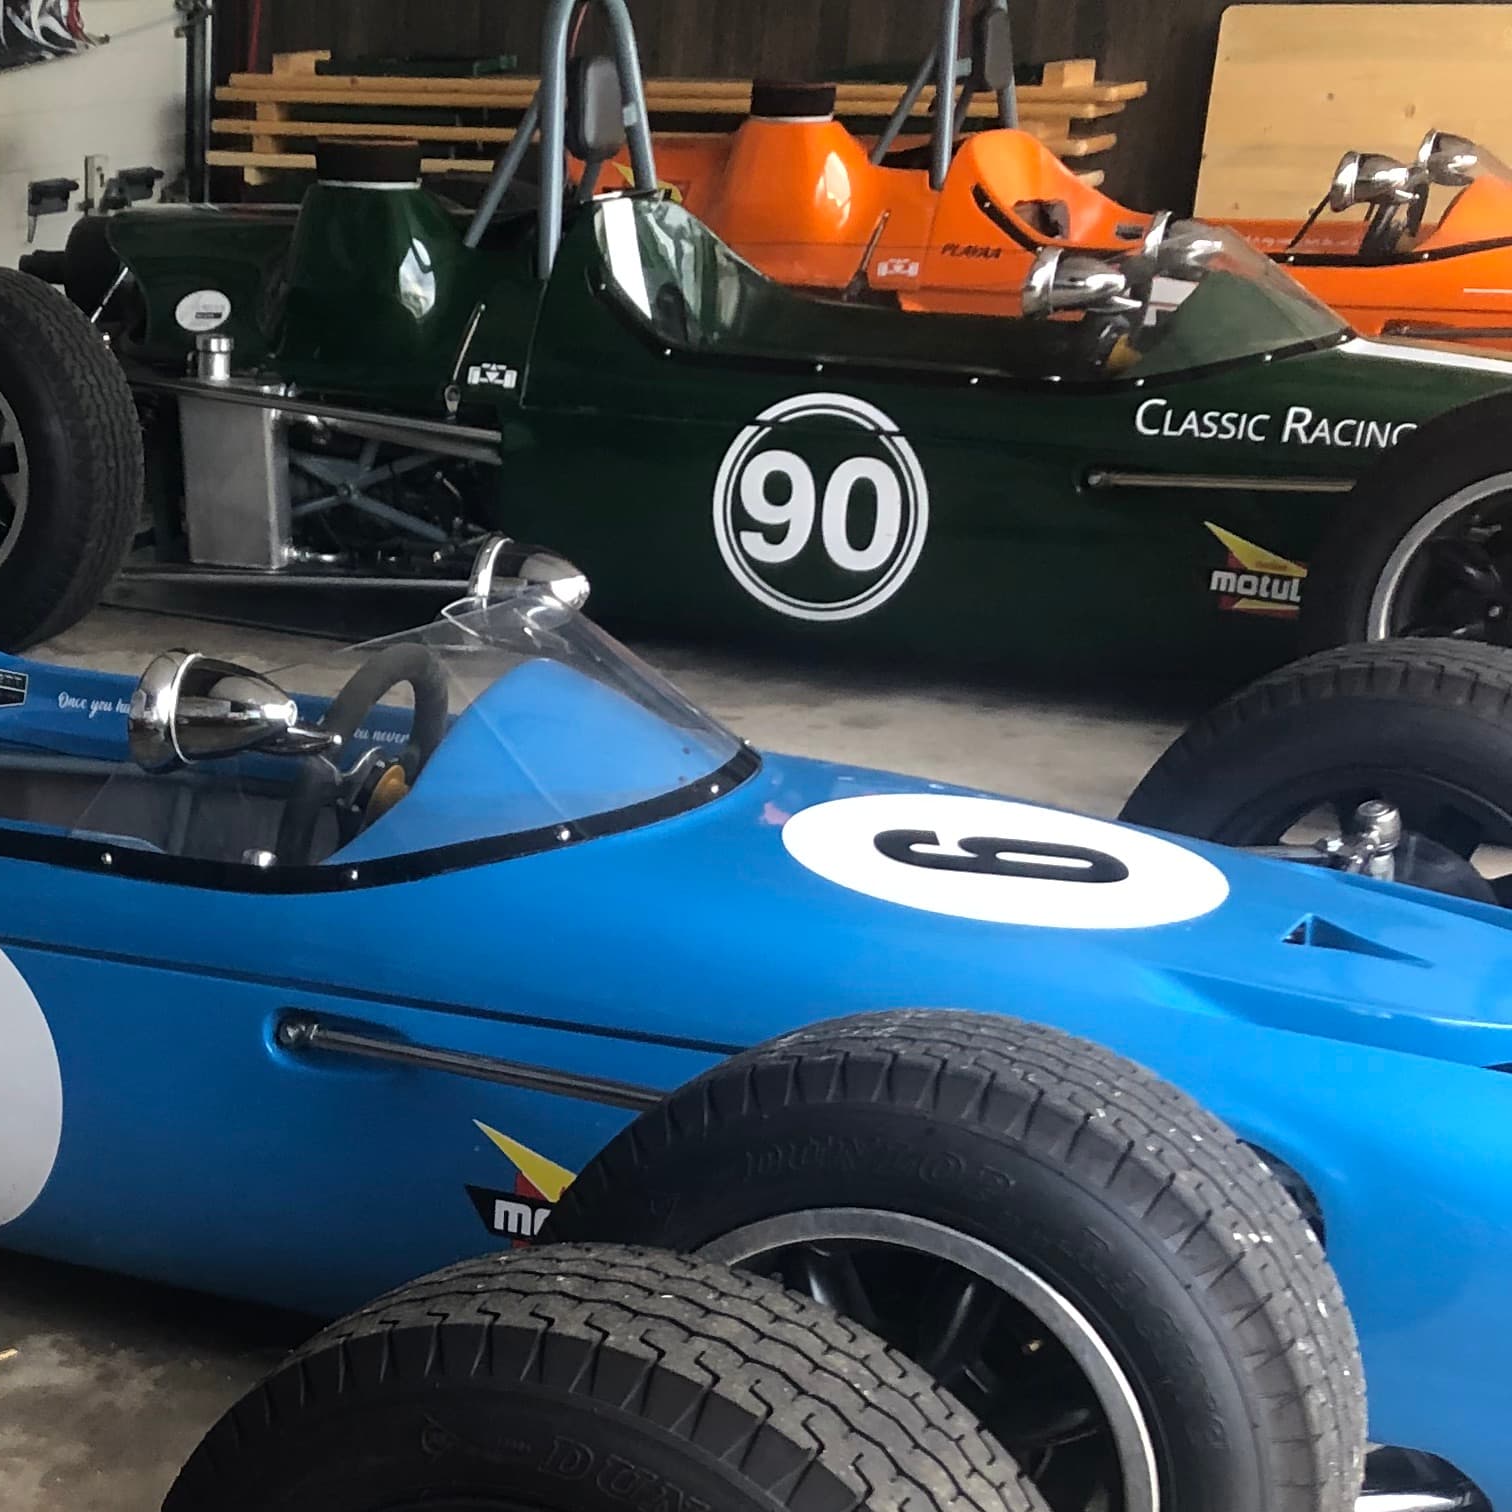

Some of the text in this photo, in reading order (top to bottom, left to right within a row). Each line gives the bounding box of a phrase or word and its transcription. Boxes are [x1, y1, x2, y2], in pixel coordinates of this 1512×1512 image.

[1134, 398, 1271, 442] CLASSIC
[738, 448, 902, 573] 90
[1209, 569, 1302, 603] motul
[57, 690, 87, 709] Once
[90, 698, 113, 719] you
[873, 827, 1130, 885] 6
